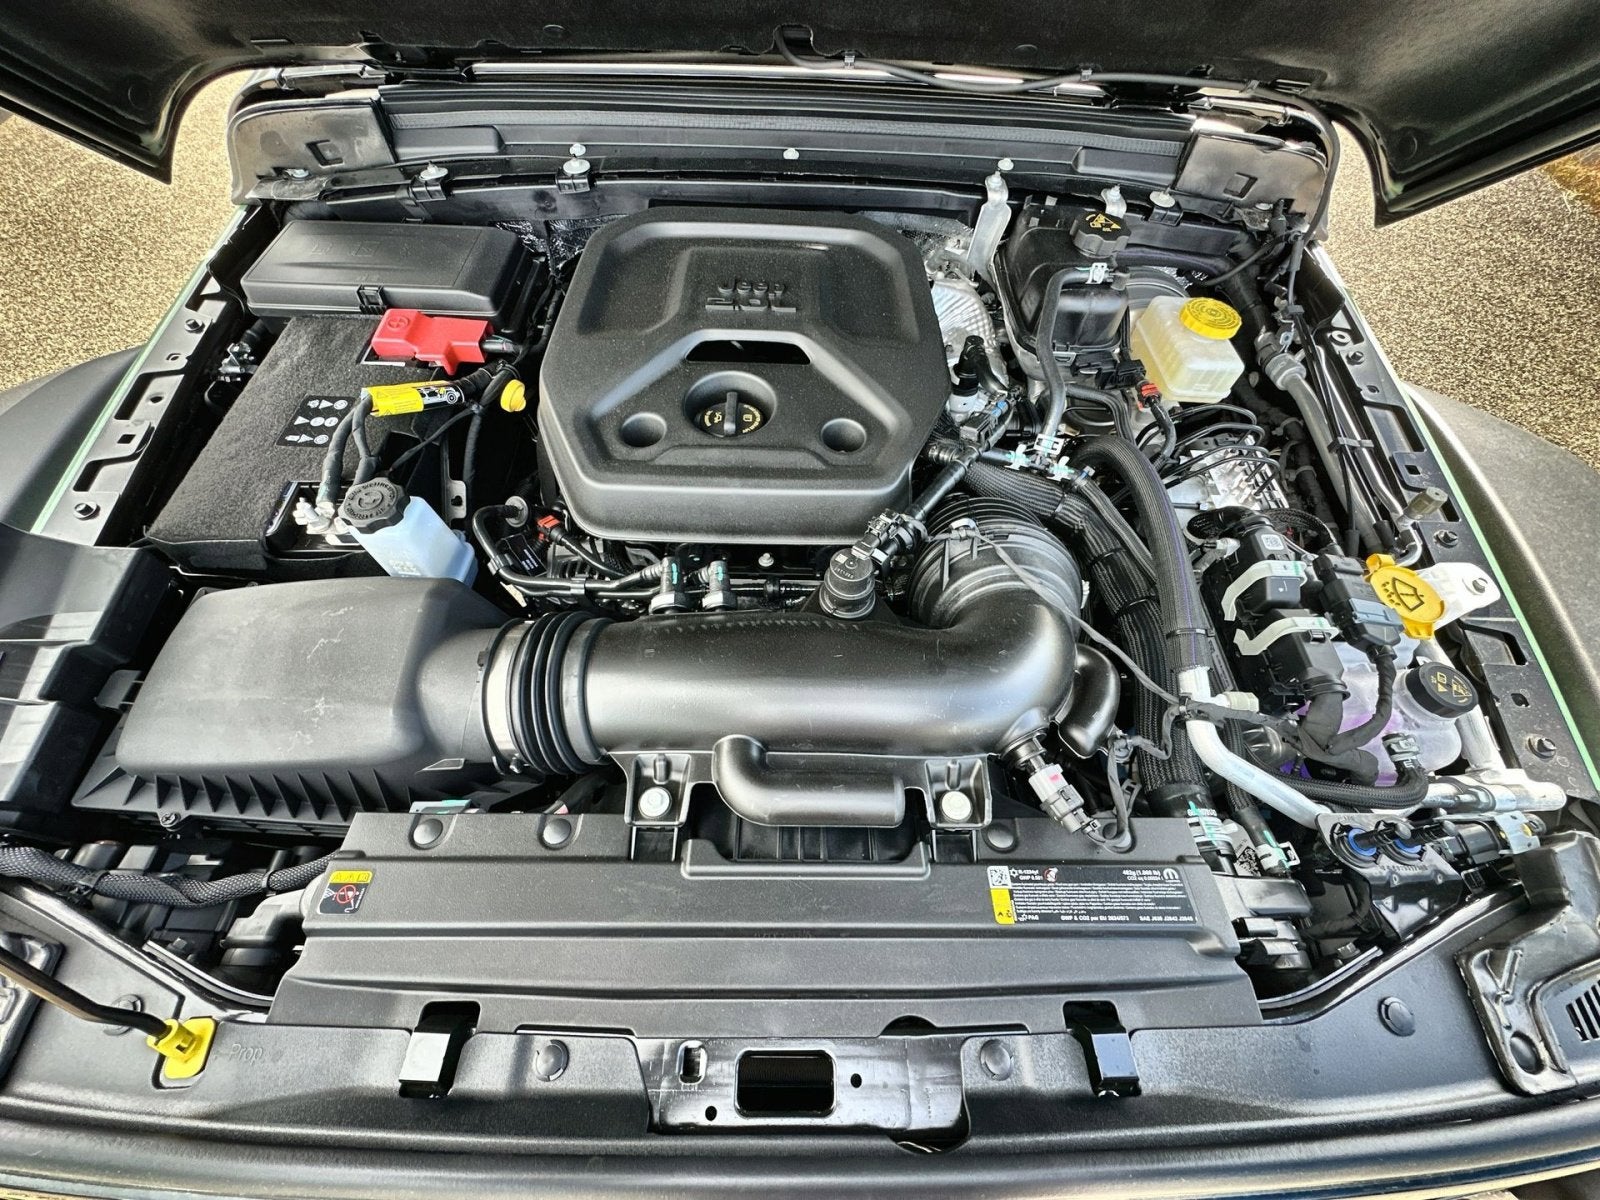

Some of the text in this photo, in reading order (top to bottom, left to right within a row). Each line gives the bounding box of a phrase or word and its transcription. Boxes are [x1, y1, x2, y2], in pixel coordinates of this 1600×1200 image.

[716, 279, 785, 299] Jeep
[704, 296, 798, 313] 2.0L
[230, 1043, 264, 1066] Prop
